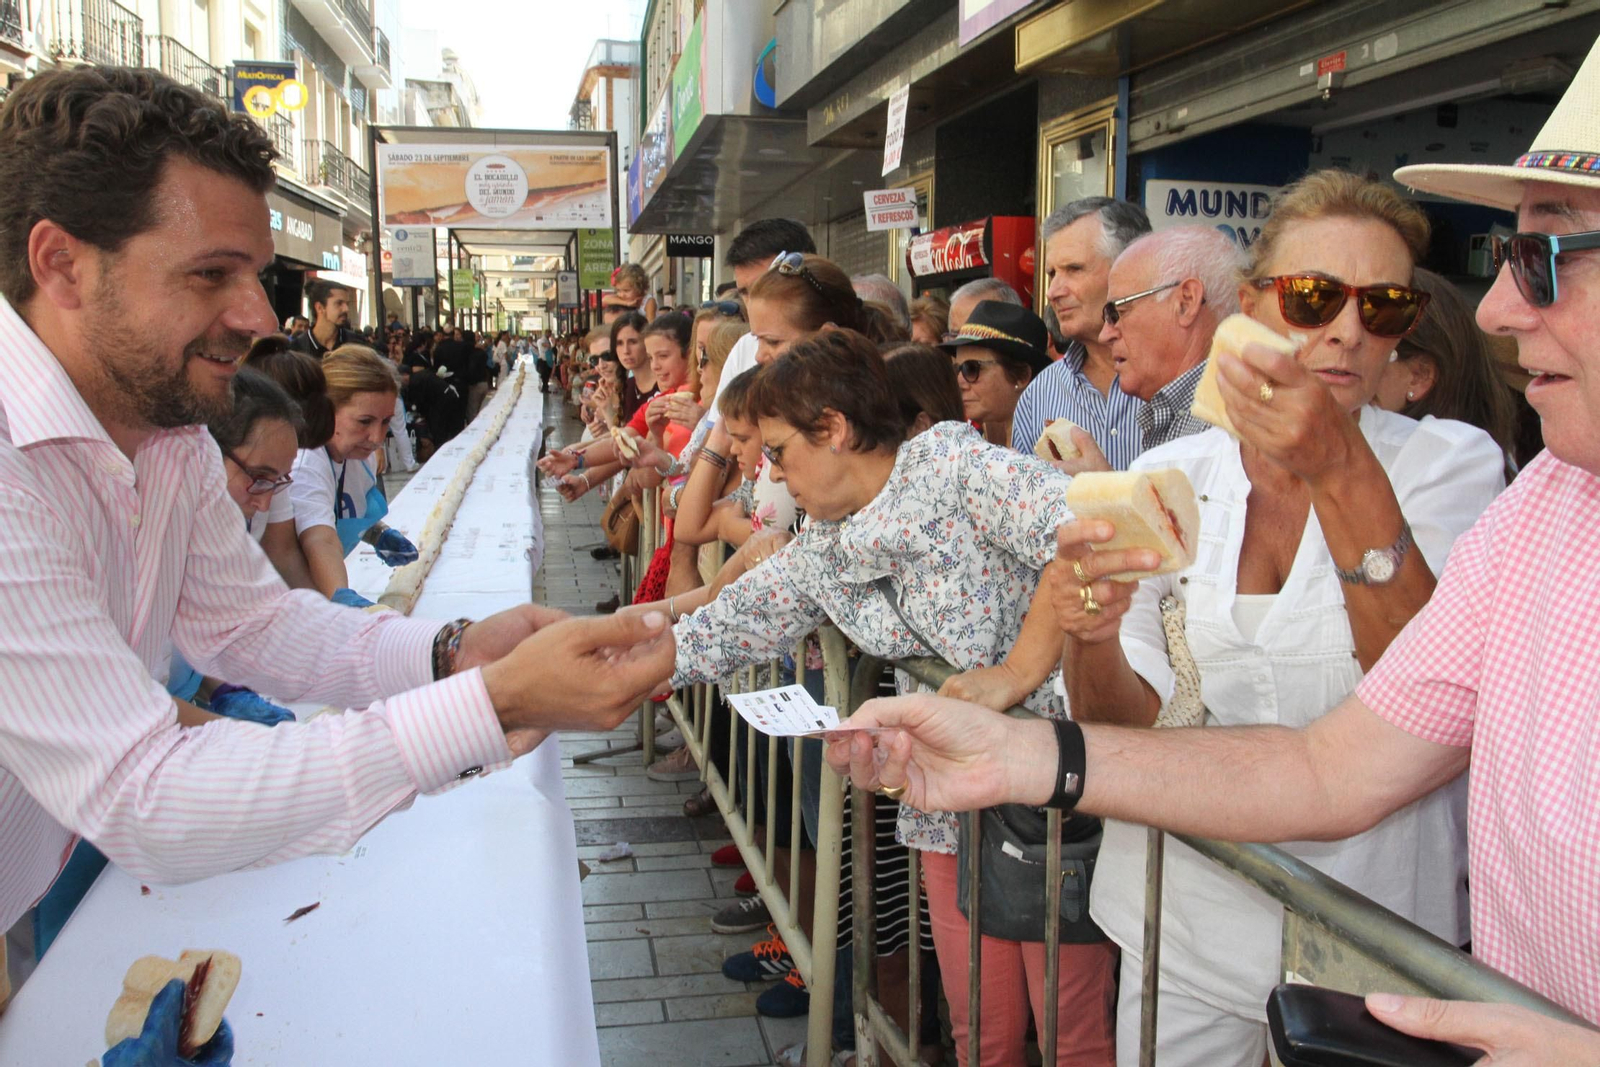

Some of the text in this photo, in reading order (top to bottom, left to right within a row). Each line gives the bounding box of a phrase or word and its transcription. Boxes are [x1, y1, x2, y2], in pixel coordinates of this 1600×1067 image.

[388, 152, 413, 161] SÁBADO
[415, 153, 423, 161] 23
[433, 154, 469, 162] SEPTIEMBRE
[873, 192, 906, 206] CERVEZAS
[1165, 188, 1274, 219] MUND
[871, 209, 914, 225] Y REFRESCOS
[583, 239, 614, 249] ZONA
[670, 235, 714, 245] MANGO
[584, 263, 614, 273] AREA
